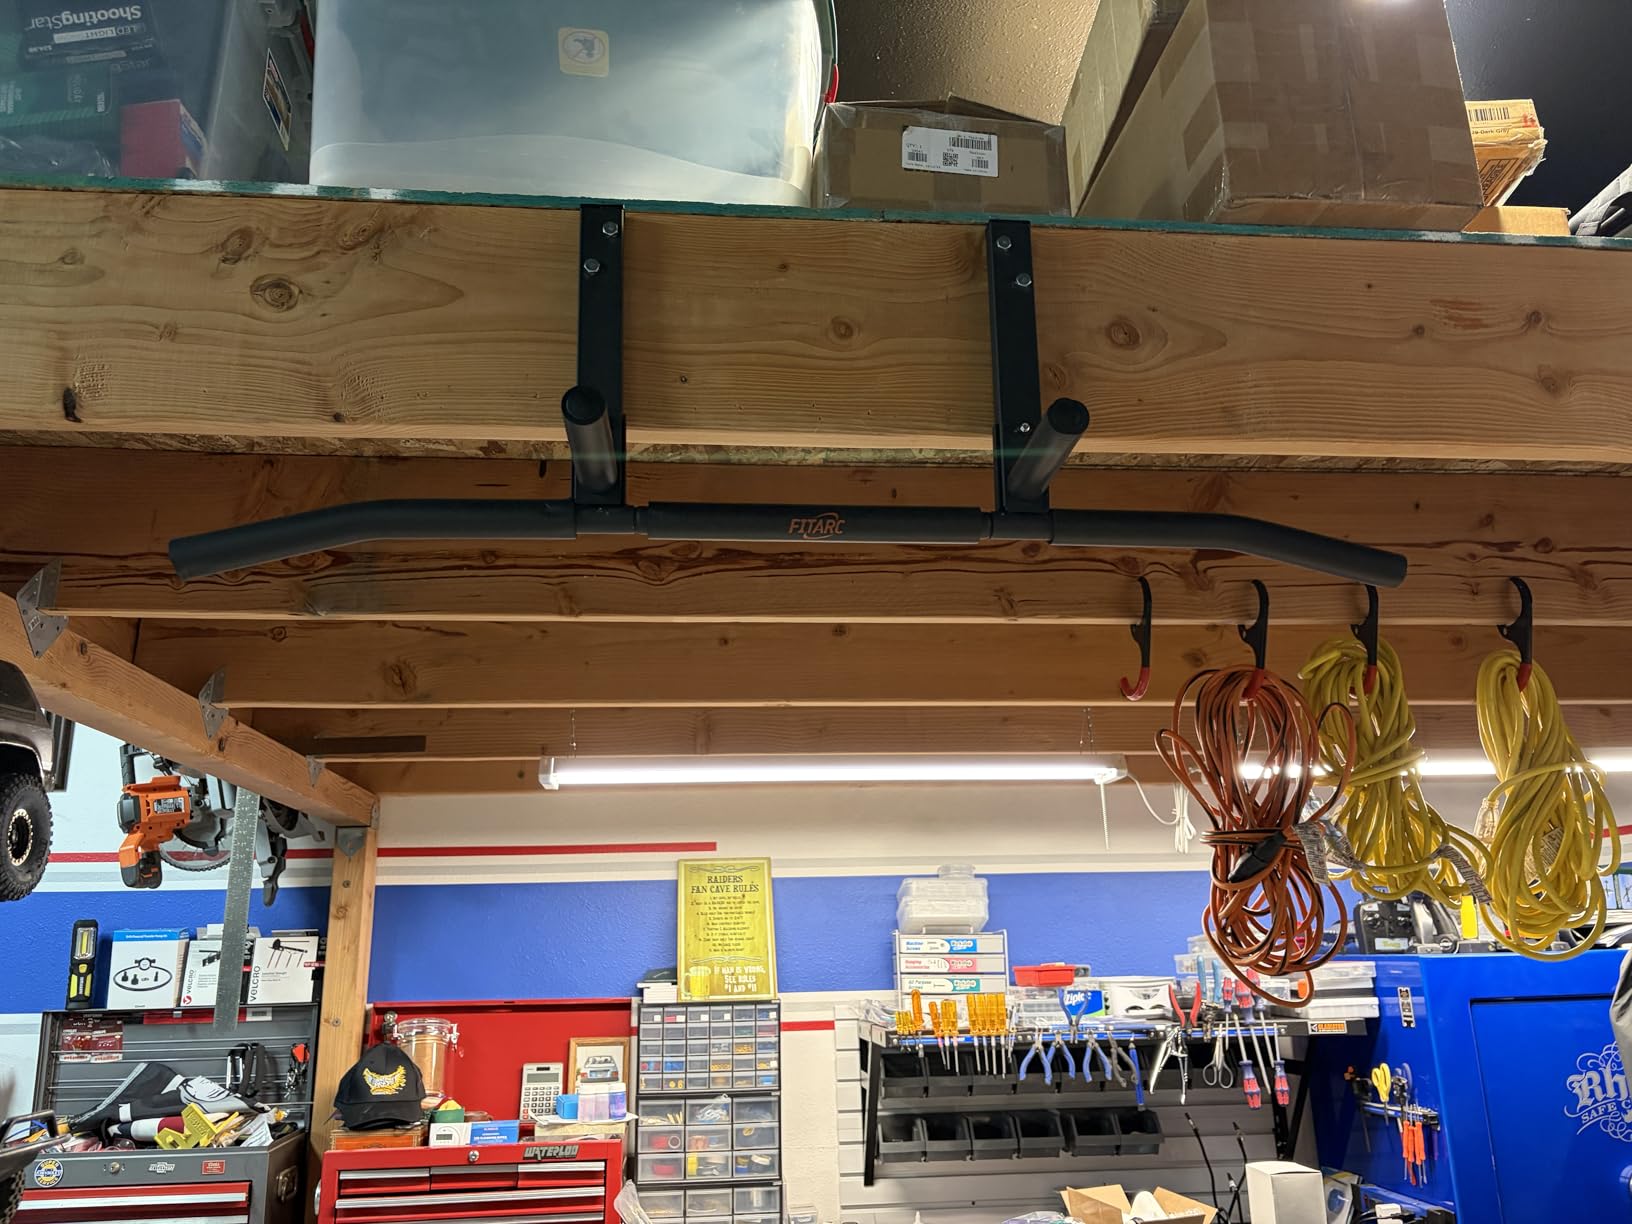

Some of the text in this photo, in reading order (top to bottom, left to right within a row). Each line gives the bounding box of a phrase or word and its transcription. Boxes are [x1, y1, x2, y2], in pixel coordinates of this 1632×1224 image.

[31, 5, 142, 30] ShootingStar
[788, 518, 846, 534] FITARC
[707, 875, 743, 884] RAIDERS
[691, 884, 760, 894] FAN CAVE RULES
[724, 975, 737, 983] SEE
[1581, 1102, 1618, 1124] SAFE
[523, 1144, 580, 1161] WATERLOO
